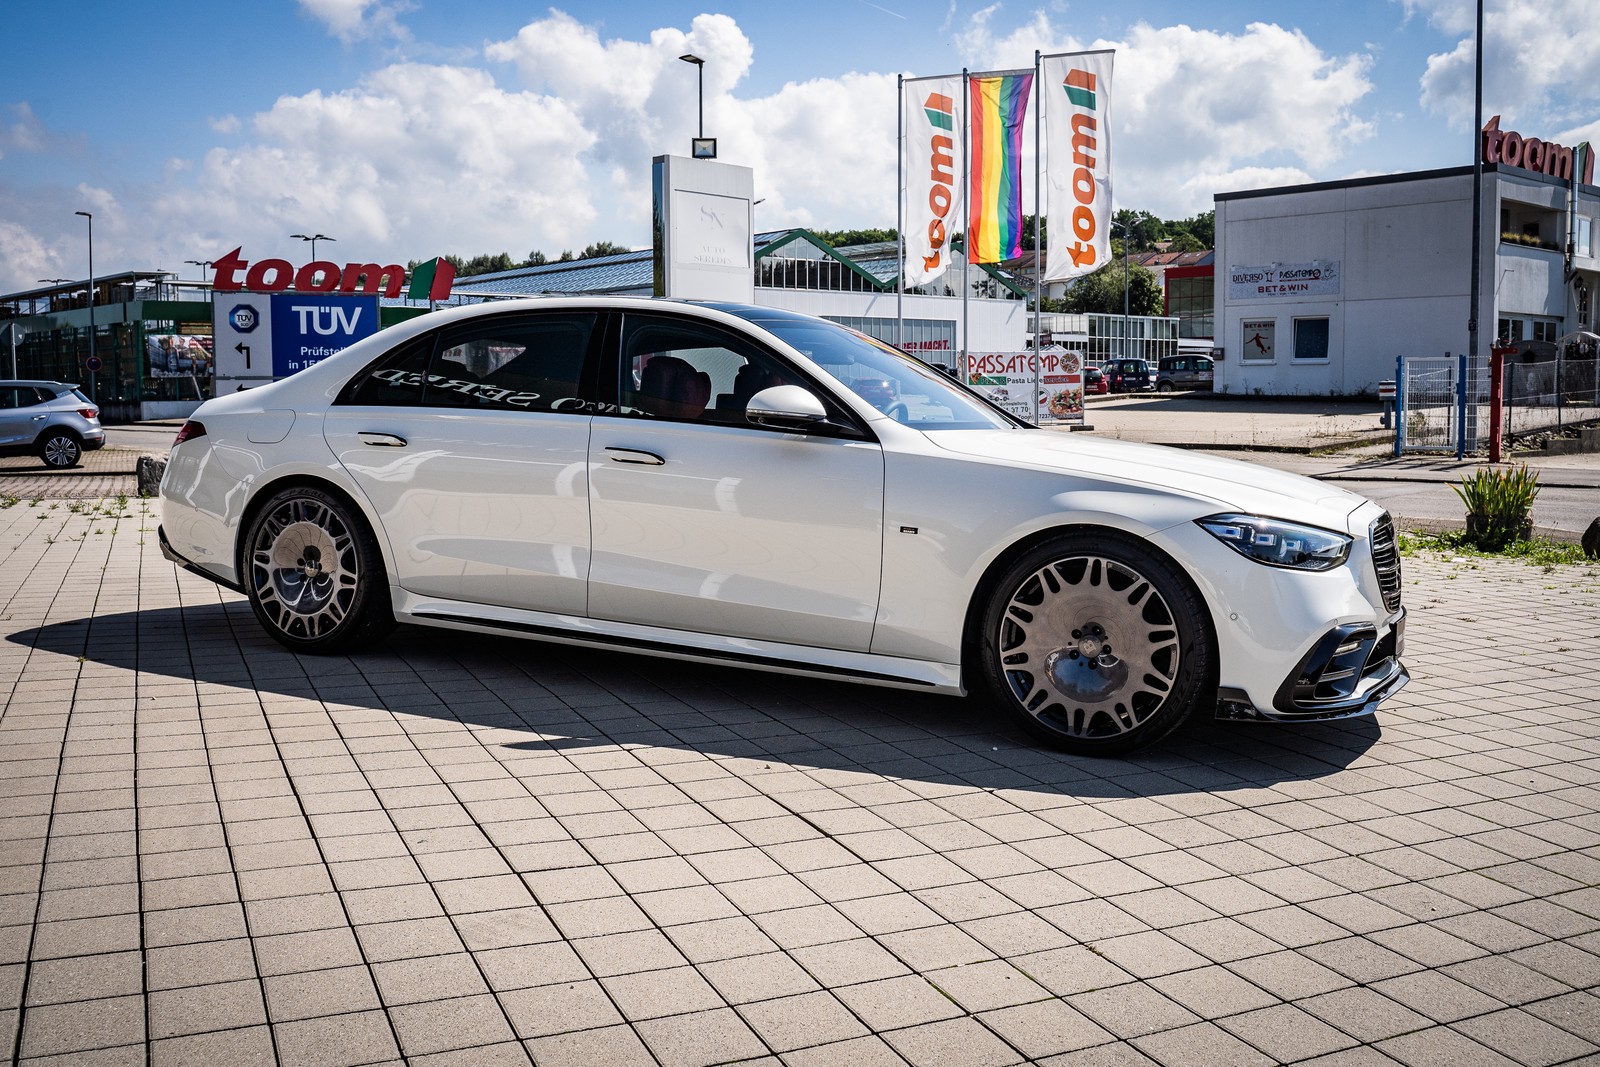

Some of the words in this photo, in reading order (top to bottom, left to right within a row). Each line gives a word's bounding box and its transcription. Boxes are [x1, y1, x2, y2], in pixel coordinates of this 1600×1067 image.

[1482, 115, 1573, 180] toom
[1067, 113, 1097, 268] toom
[922, 134, 954, 272] toom
[702, 245, 726, 254] AUTO
[210, 246, 405, 298] toom
[236, 314, 252, 322] TÜV
[291, 306, 363, 335] TÜV
[300, 346, 346, 356] Prüfste
[288, 360, 299, 369] in
[1027, 376, 1069, 384] Lieerservice
